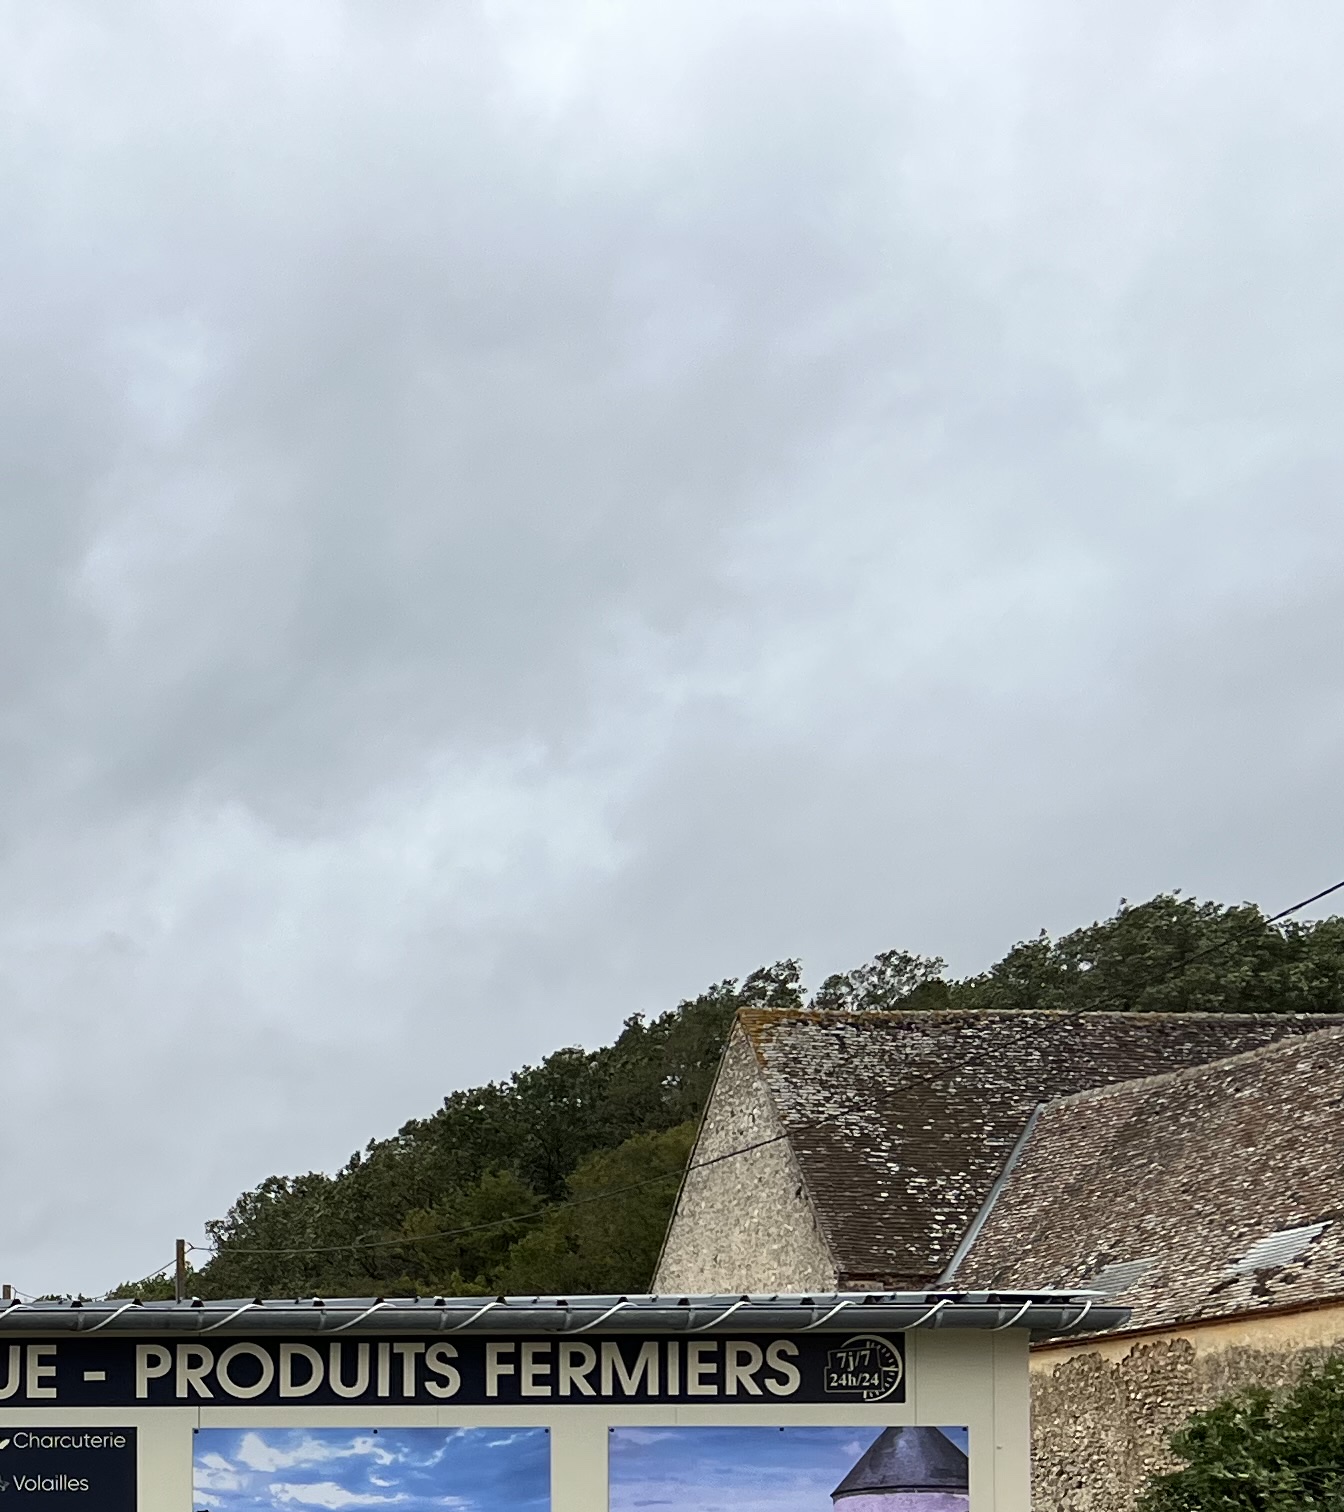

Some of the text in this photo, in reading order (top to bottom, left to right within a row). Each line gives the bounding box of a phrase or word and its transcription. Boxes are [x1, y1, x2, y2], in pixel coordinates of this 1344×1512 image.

[836, 1350, 870, 1372] 7j/7
[136, 1340, 461, 1400] PRODUITS
[486, 1340, 801, 1398] FERMIERS
[830, 1373, 879, 1386] 24h/24
[13, 1432, 126, 1448] Charcuterie
[13, 1475, 88, 1491] Volailles
